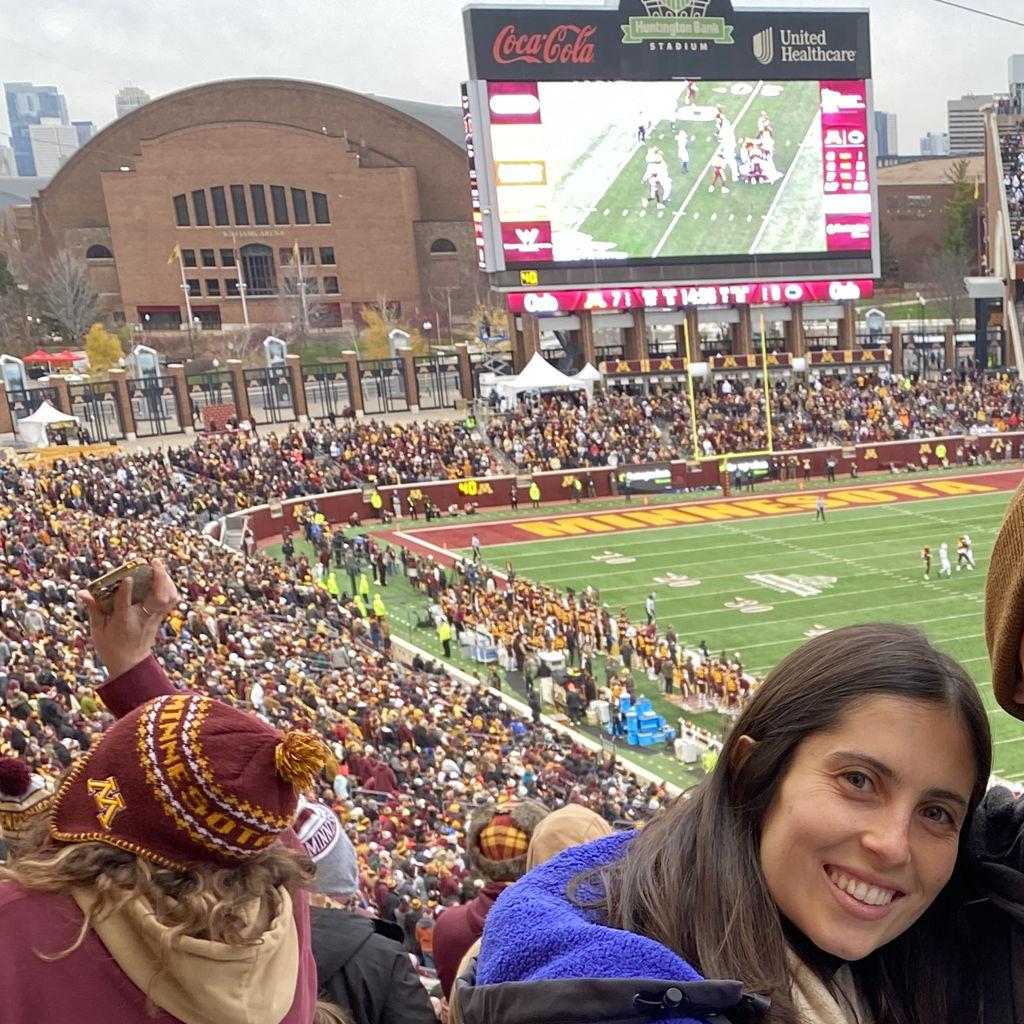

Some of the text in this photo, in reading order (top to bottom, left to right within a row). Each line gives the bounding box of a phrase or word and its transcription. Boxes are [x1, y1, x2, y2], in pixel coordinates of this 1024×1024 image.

[635, 20, 719, 36] Huntington Bank
[780, 29, 827, 46] United
[649, 42, 709, 51] STADIUM
[781, 46, 855, 62] Healthcare
[513, 480, 999, 538] MINNESOTA
[86, 775, 127, 832] M
